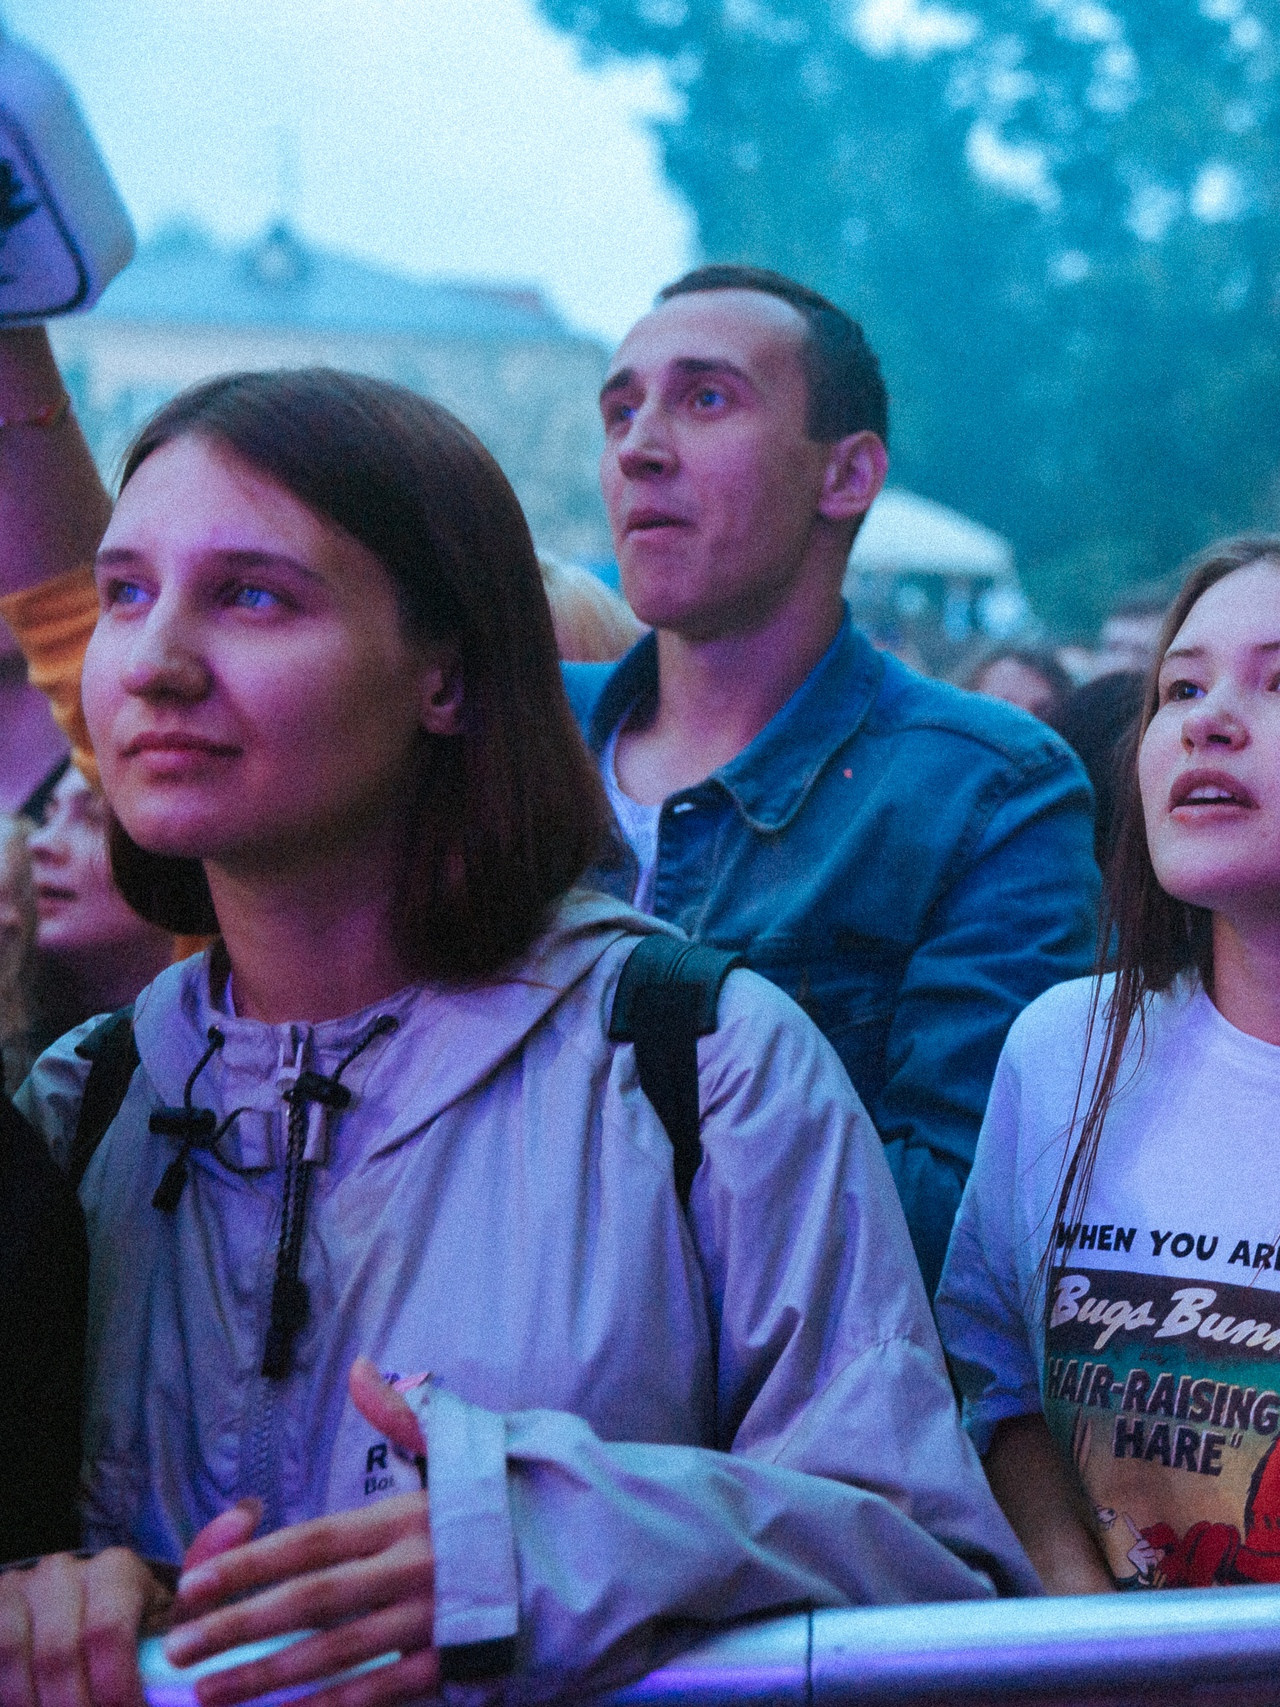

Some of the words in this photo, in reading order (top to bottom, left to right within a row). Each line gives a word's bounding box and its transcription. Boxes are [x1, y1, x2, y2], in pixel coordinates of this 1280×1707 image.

[1056, 1222, 1137, 1253] WHEN
[1150, 1230, 1219, 1261] YOU
[1049, 1274, 1157, 1350] Bugs
